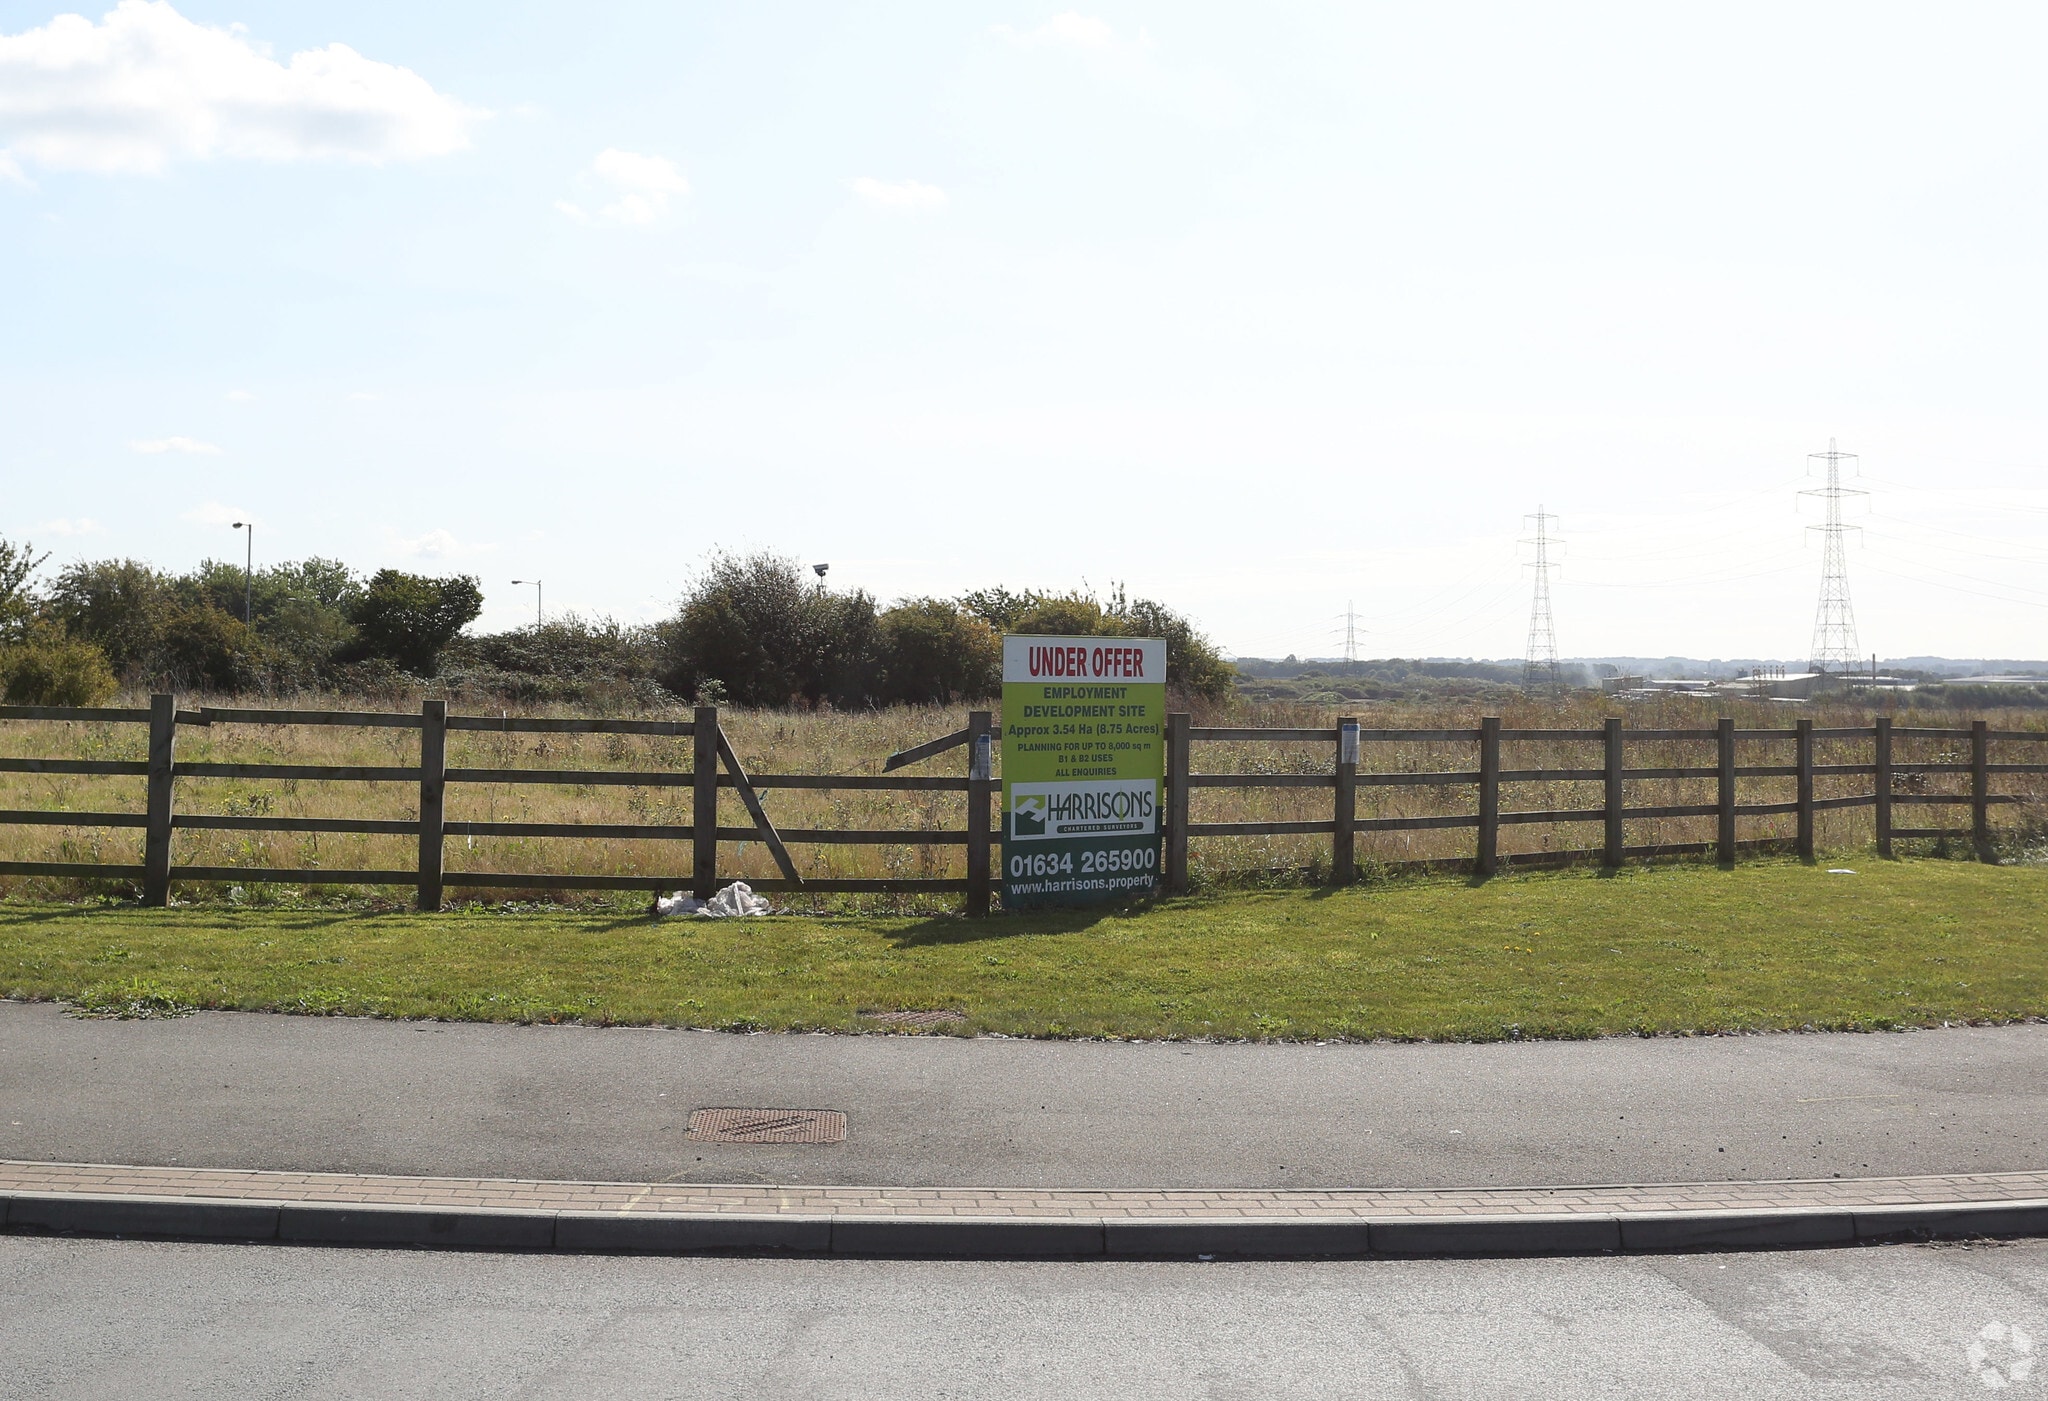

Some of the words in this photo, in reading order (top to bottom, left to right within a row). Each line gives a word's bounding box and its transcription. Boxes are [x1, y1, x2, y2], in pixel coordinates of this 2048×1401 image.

[1029, 646, 1087, 677] UNDER
[1092, 647, 1144, 677] OFFER
[1043, 687, 1127, 699] EMPLOYMENT
[1024, 705, 1115, 717] DEVELOPMENT
[1118, 705, 1146, 717] SITE
[1009, 725, 1050, 738] Approx
[1052, 724, 1075, 735] 3.54
[1079, 724, 1093, 735] Ha
[1096, 723, 1123, 736] (8.75
[1126, 723, 1159, 735] Acres)
[1017, 743, 1062, 752] PLANNING
[1064, 743, 1080, 751] FOR
[1095, 742, 1106, 750] TO
[1132, 743, 1141, 752] sq
[1058, 755, 1068, 763] B1
[1091, 754, 1113, 762] USES
[1055, 769, 1070, 777] ALL
[1072, 768, 1117, 777] ENQUIRIES
[1047, 790, 1152, 821] HARRISONS
[1010, 852, 1073, 878] 01634
[1081, 847, 1155, 873] 265900
[1011, 874, 1154, 895] www.harrisons.property
